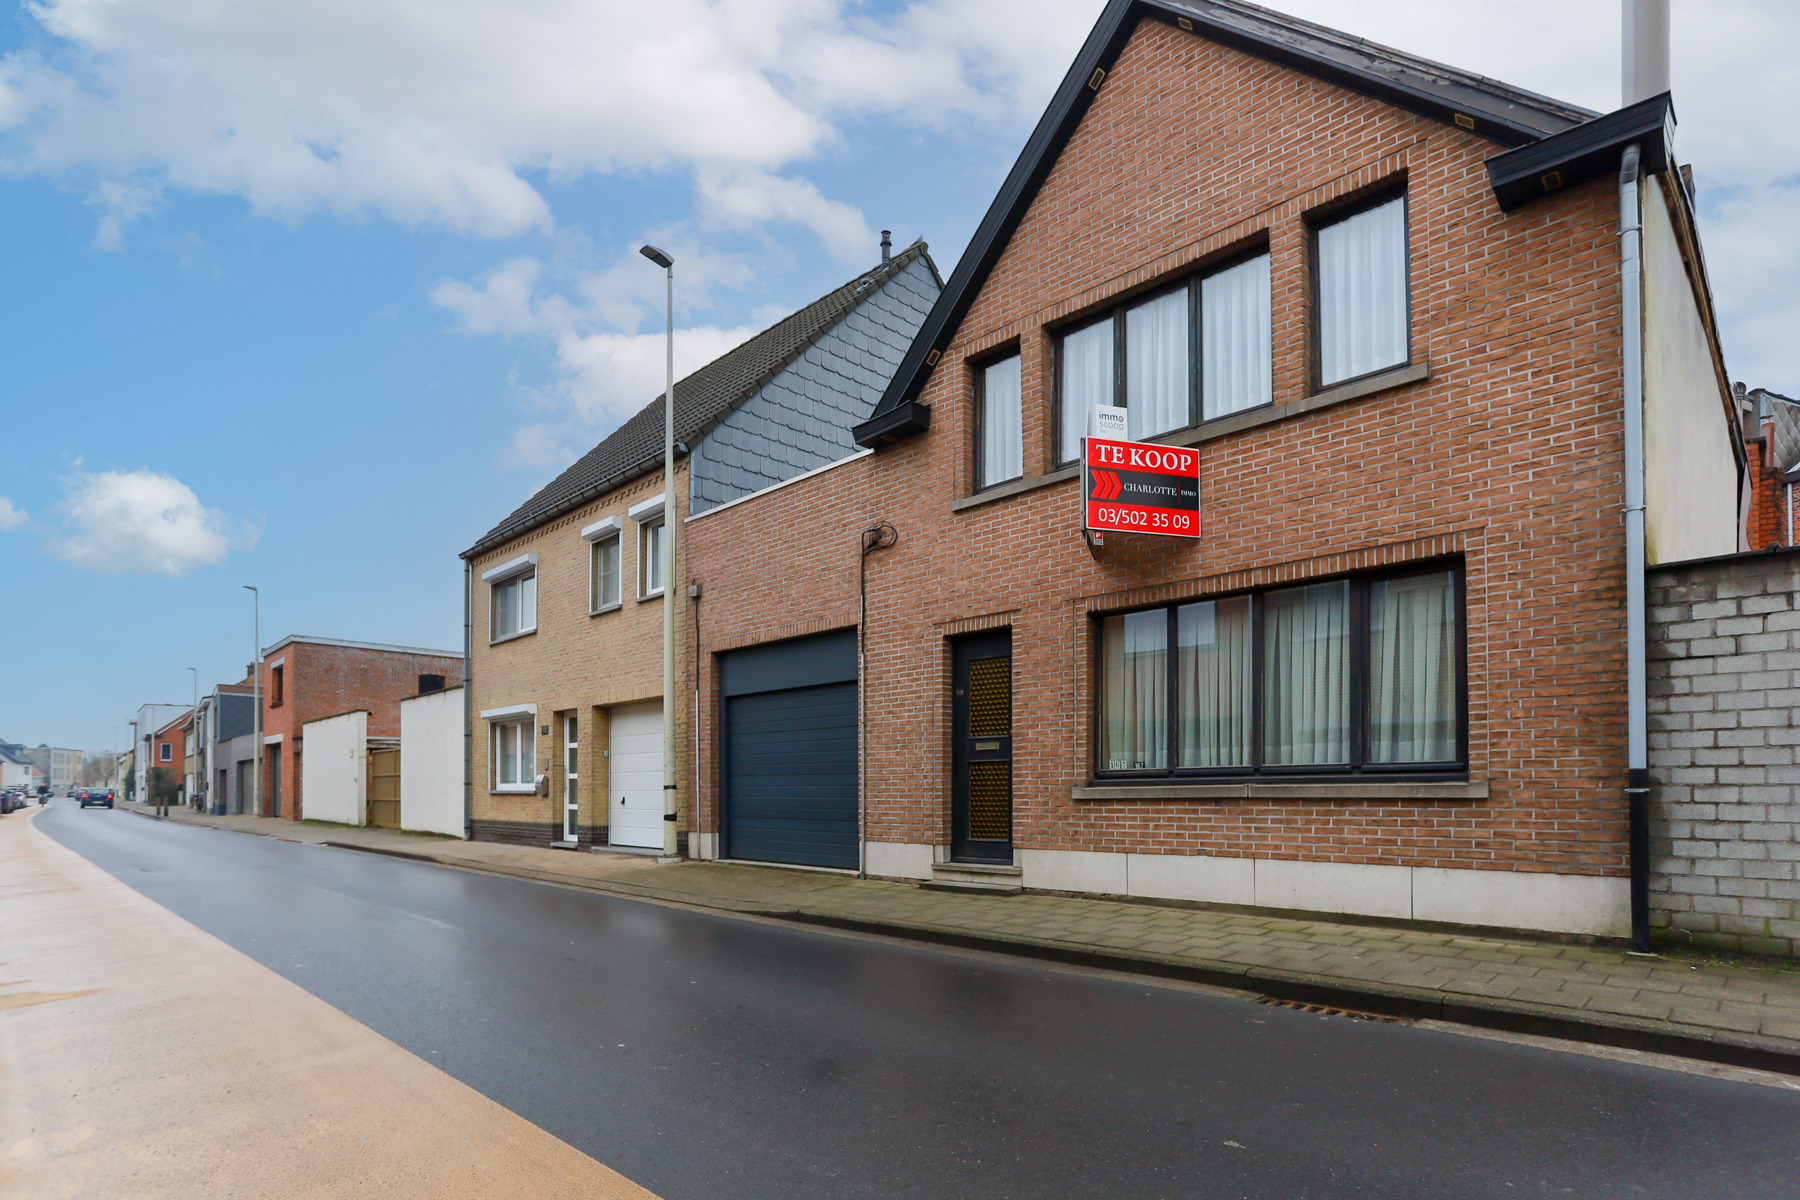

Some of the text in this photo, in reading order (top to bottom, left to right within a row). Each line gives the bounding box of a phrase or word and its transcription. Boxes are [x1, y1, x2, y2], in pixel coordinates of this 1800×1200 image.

[1098, 411, 1124, 423] immo
[1099, 421, 1124, 431] scoop
[1095, 444, 1192, 471] TE KOOP
[1123, 482, 1197, 497] CHARLOTTE IMMO
[1098, 507, 1190, 529] 03/502 35 09
